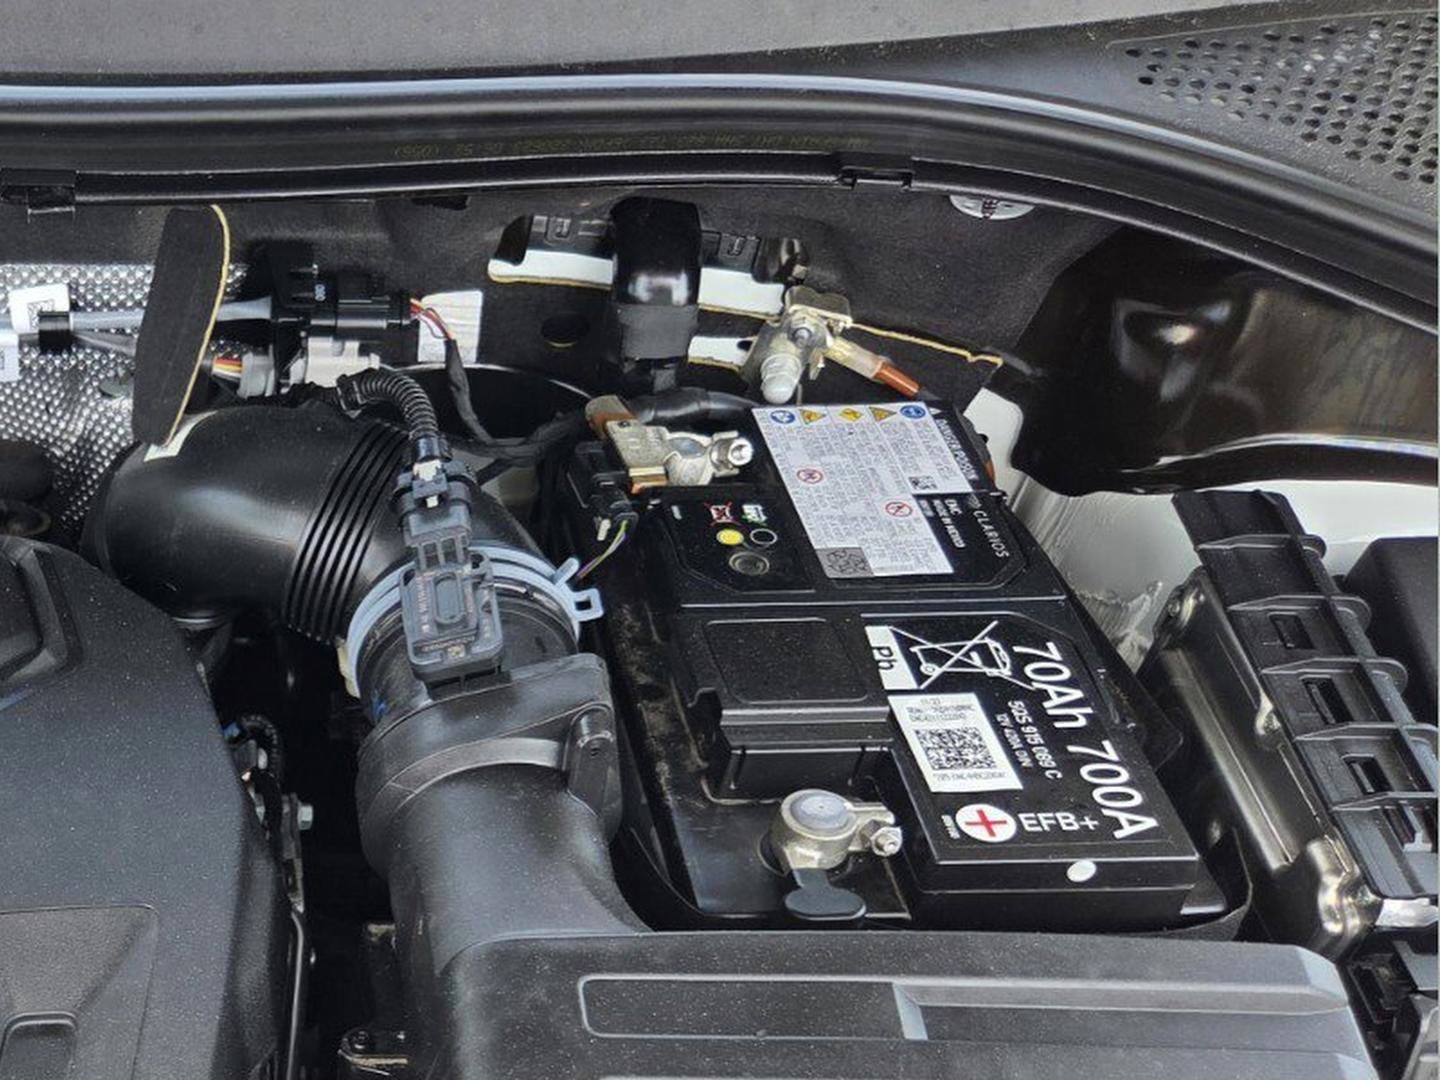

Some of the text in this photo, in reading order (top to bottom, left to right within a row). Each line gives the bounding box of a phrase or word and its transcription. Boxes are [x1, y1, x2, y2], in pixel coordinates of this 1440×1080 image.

[954, 449, 980, 481] POISON
[972, 510, 1010, 558] CLARIOS
[873, 645, 901, 673] Pb
[1012, 641, 1159, 840] 70Ah 700A
[1020, 725, 1044, 746] 915
[1044, 768, 1063, 780] C
[1017, 811, 1100, 832] EFB+
